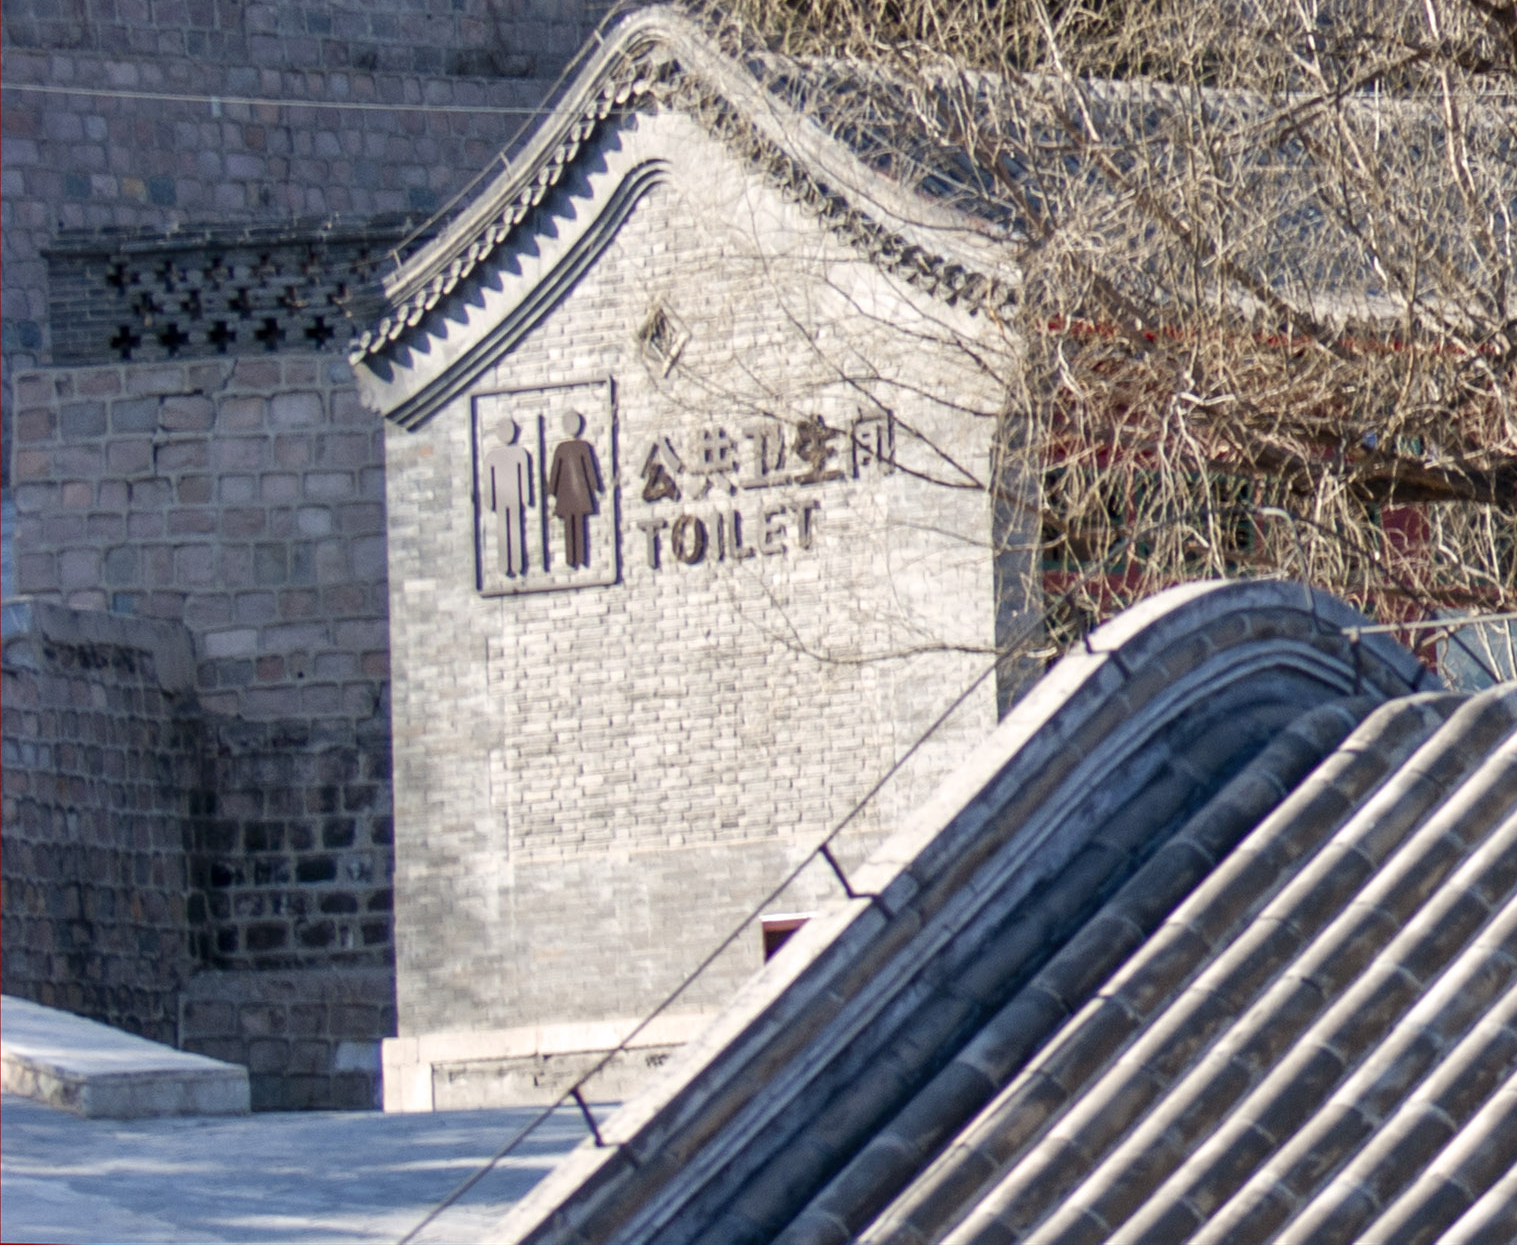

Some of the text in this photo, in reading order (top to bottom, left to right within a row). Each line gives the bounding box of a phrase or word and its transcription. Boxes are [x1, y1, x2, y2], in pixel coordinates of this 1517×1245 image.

[640, 410, 895, 502] 公共卫生间
[637, 500, 820, 570] TOILET
